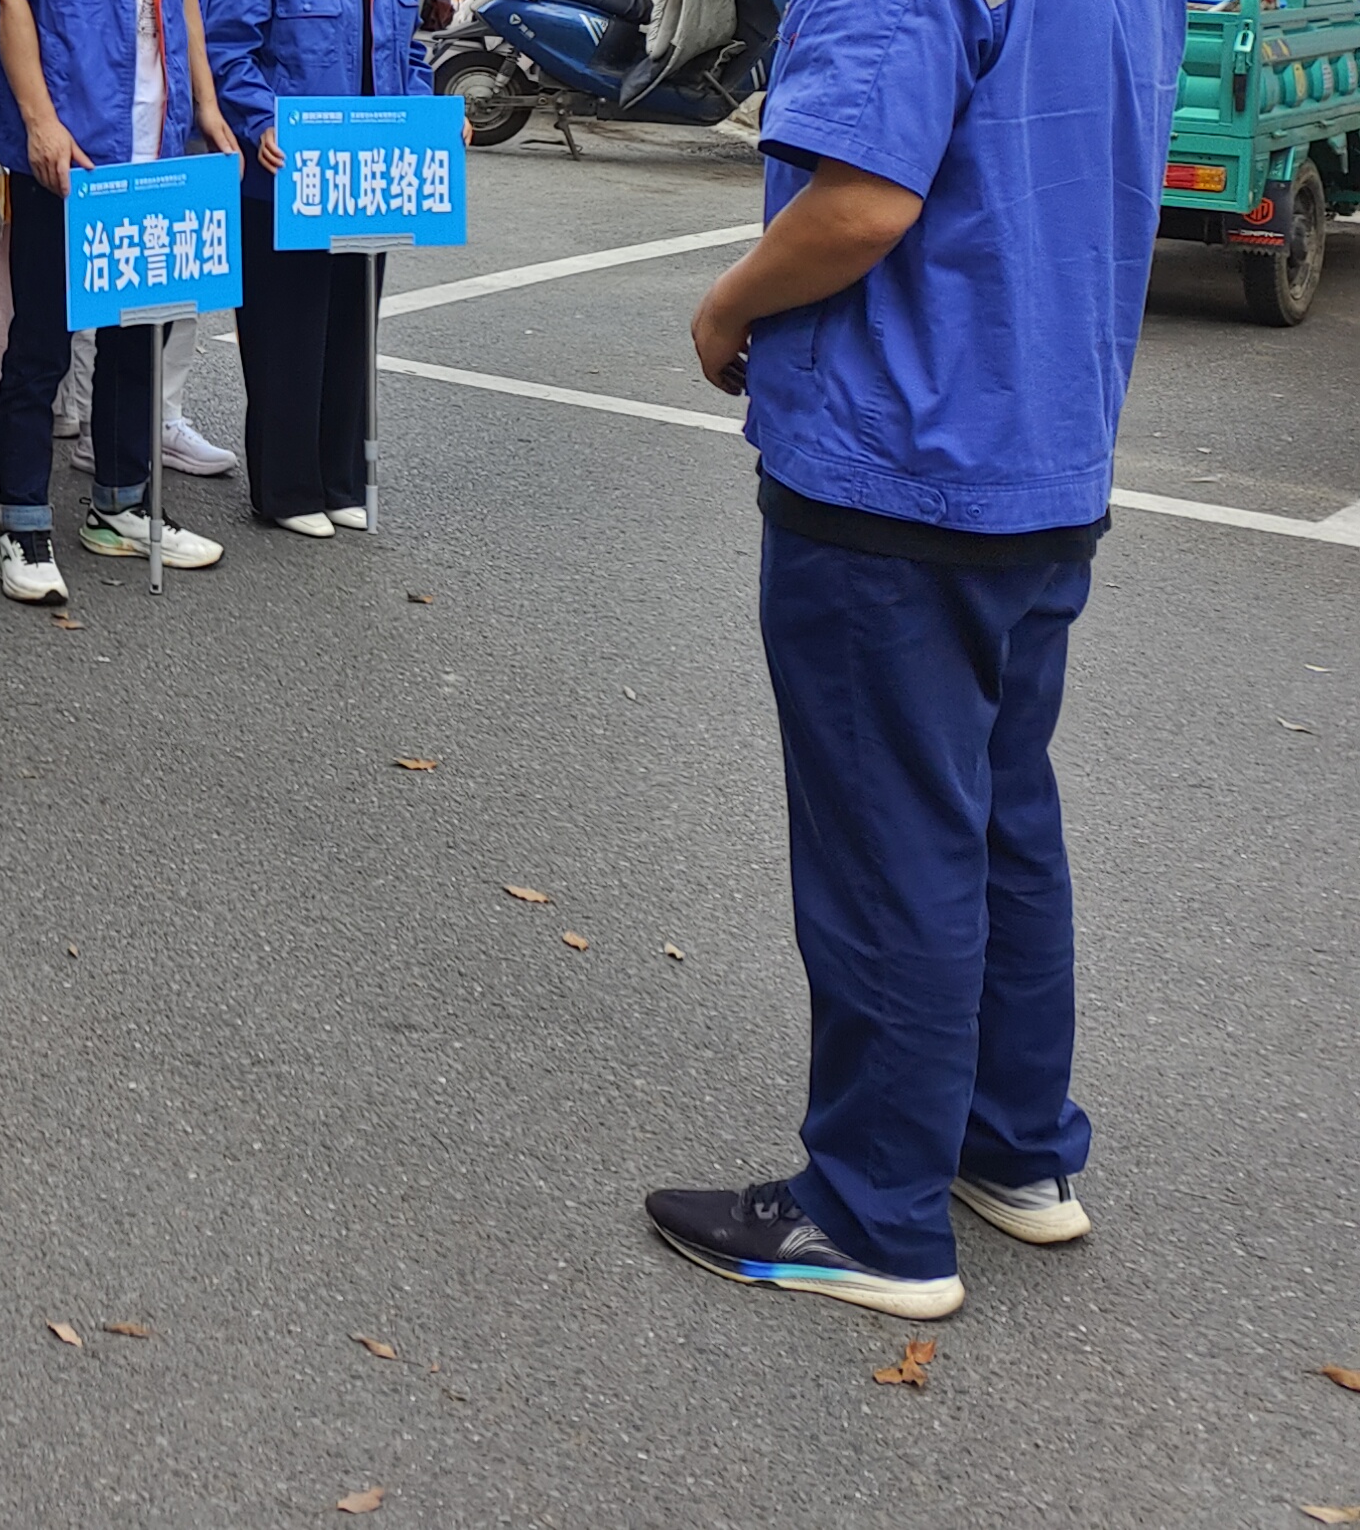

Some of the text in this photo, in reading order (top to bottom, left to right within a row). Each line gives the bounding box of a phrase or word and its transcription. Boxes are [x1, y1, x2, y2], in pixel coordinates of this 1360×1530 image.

[292, 147, 452, 216] 通讯联络组
[83, 210, 229, 292] 治安警戒组
